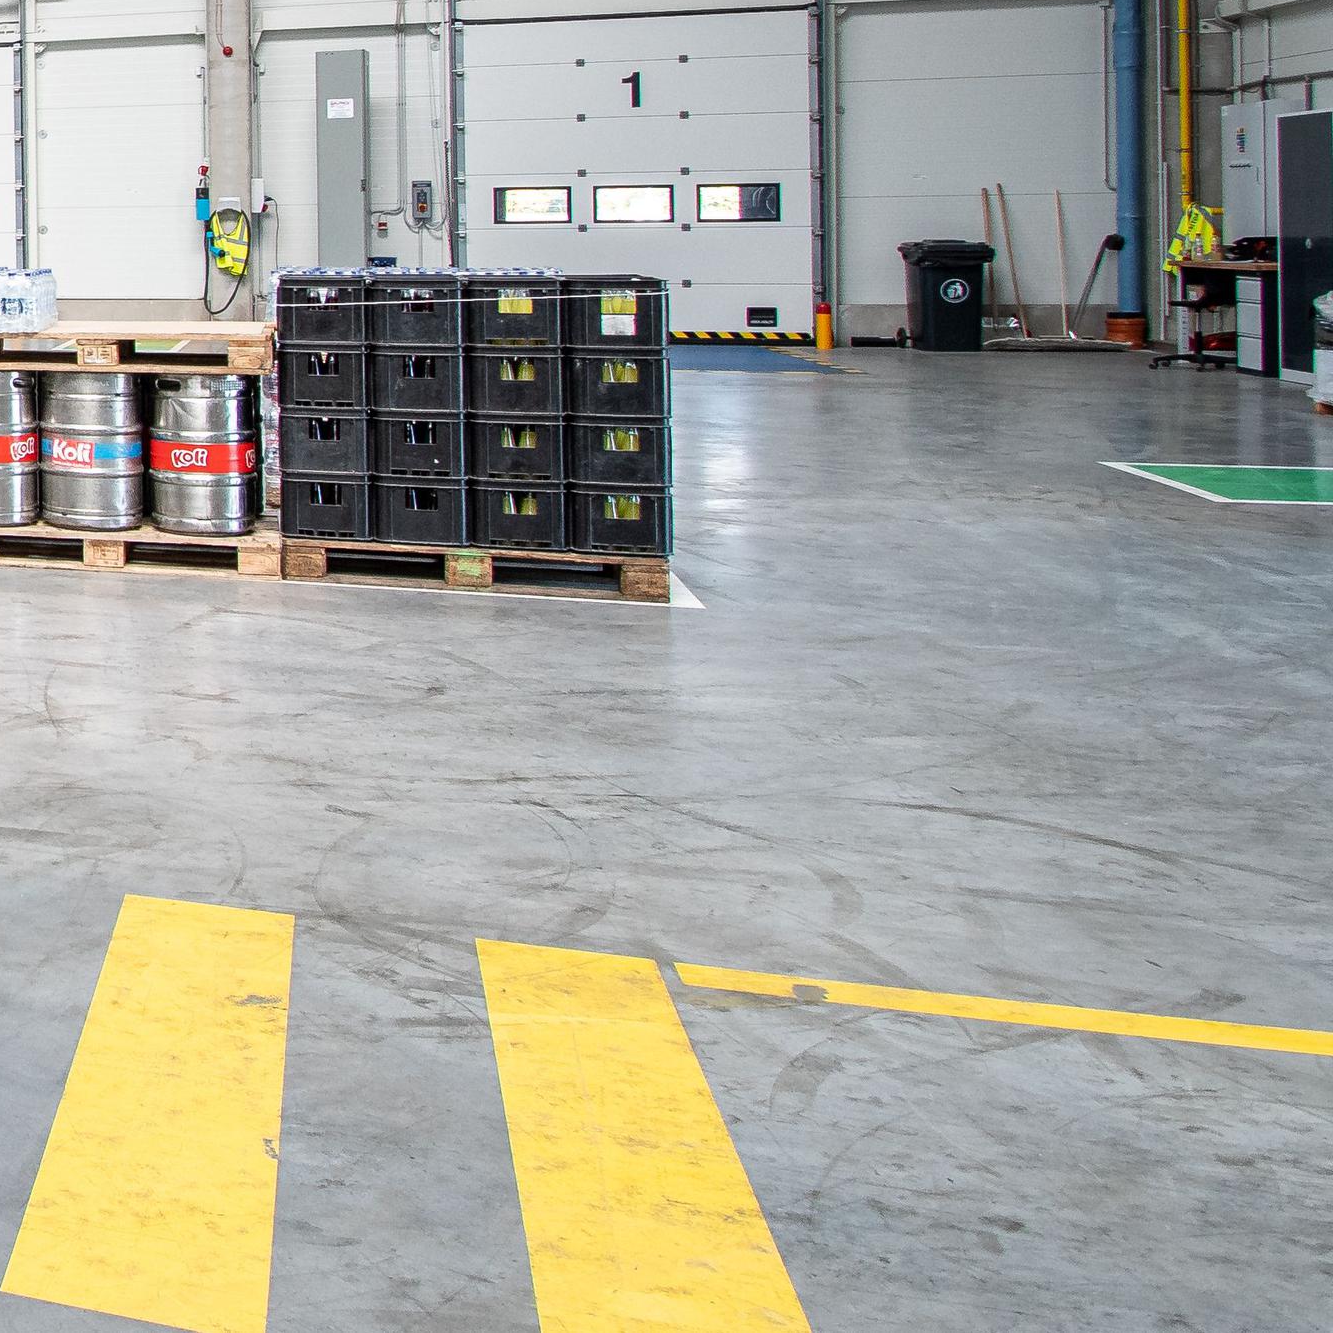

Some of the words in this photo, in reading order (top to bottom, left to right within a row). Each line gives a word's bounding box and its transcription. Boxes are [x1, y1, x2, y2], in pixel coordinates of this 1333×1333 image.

[621, 71, 641, 108] 1
[10, 437, 35, 461] Koli
[53, 438, 92, 463] Koli
[171, 448, 208, 468] Koli
